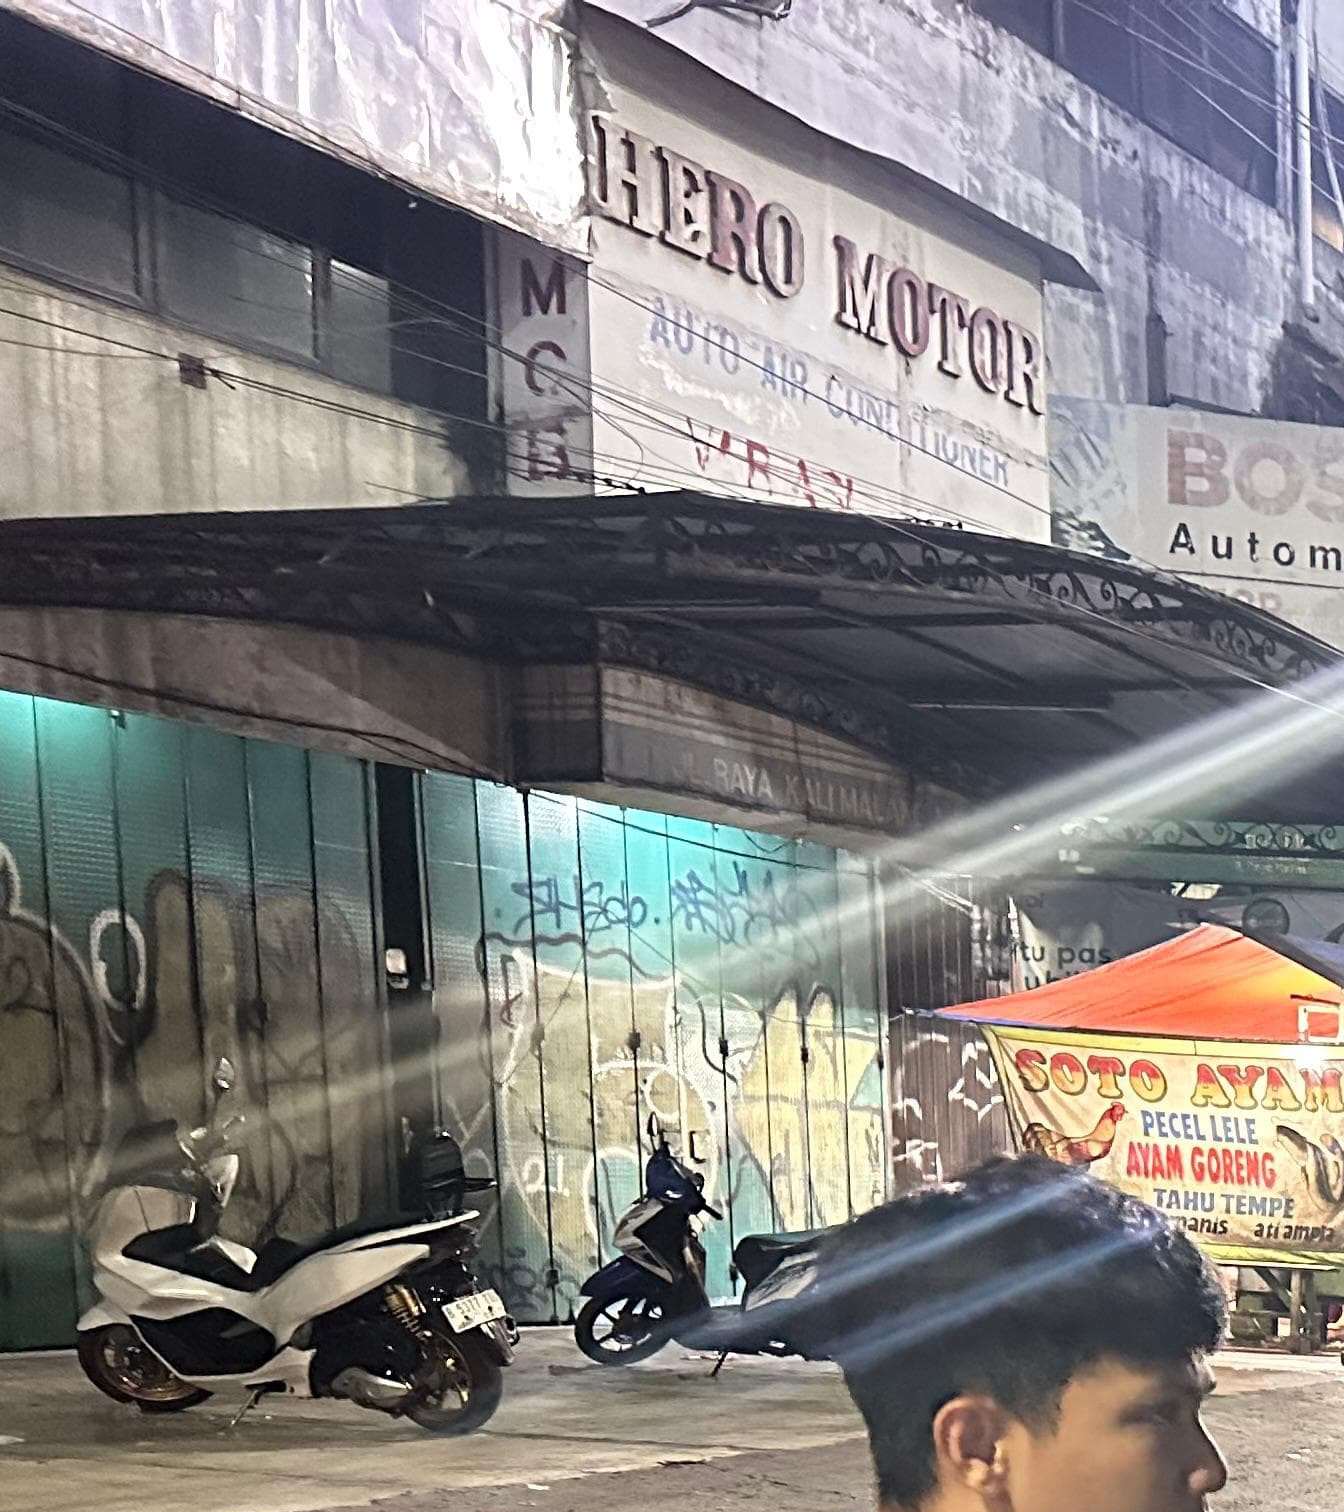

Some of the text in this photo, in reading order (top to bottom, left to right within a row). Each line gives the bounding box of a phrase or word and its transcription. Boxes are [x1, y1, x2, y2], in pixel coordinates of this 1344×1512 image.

[592, 114, 1045, 416] HERO MOTOR
[650, 300, 740, 376] AUTO
[761, 343, 809, 404] AIR
[712, 757, 774, 799] RAYA
[1014, 1048, 1168, 1102] SOTO
[1141, 1110, 1259, 1145] PECEL LELE
[1126, 1141, 1277, 1189] AYAM GORENG
[1152, 1188, 1295, 1219] TAHU TEMPE
